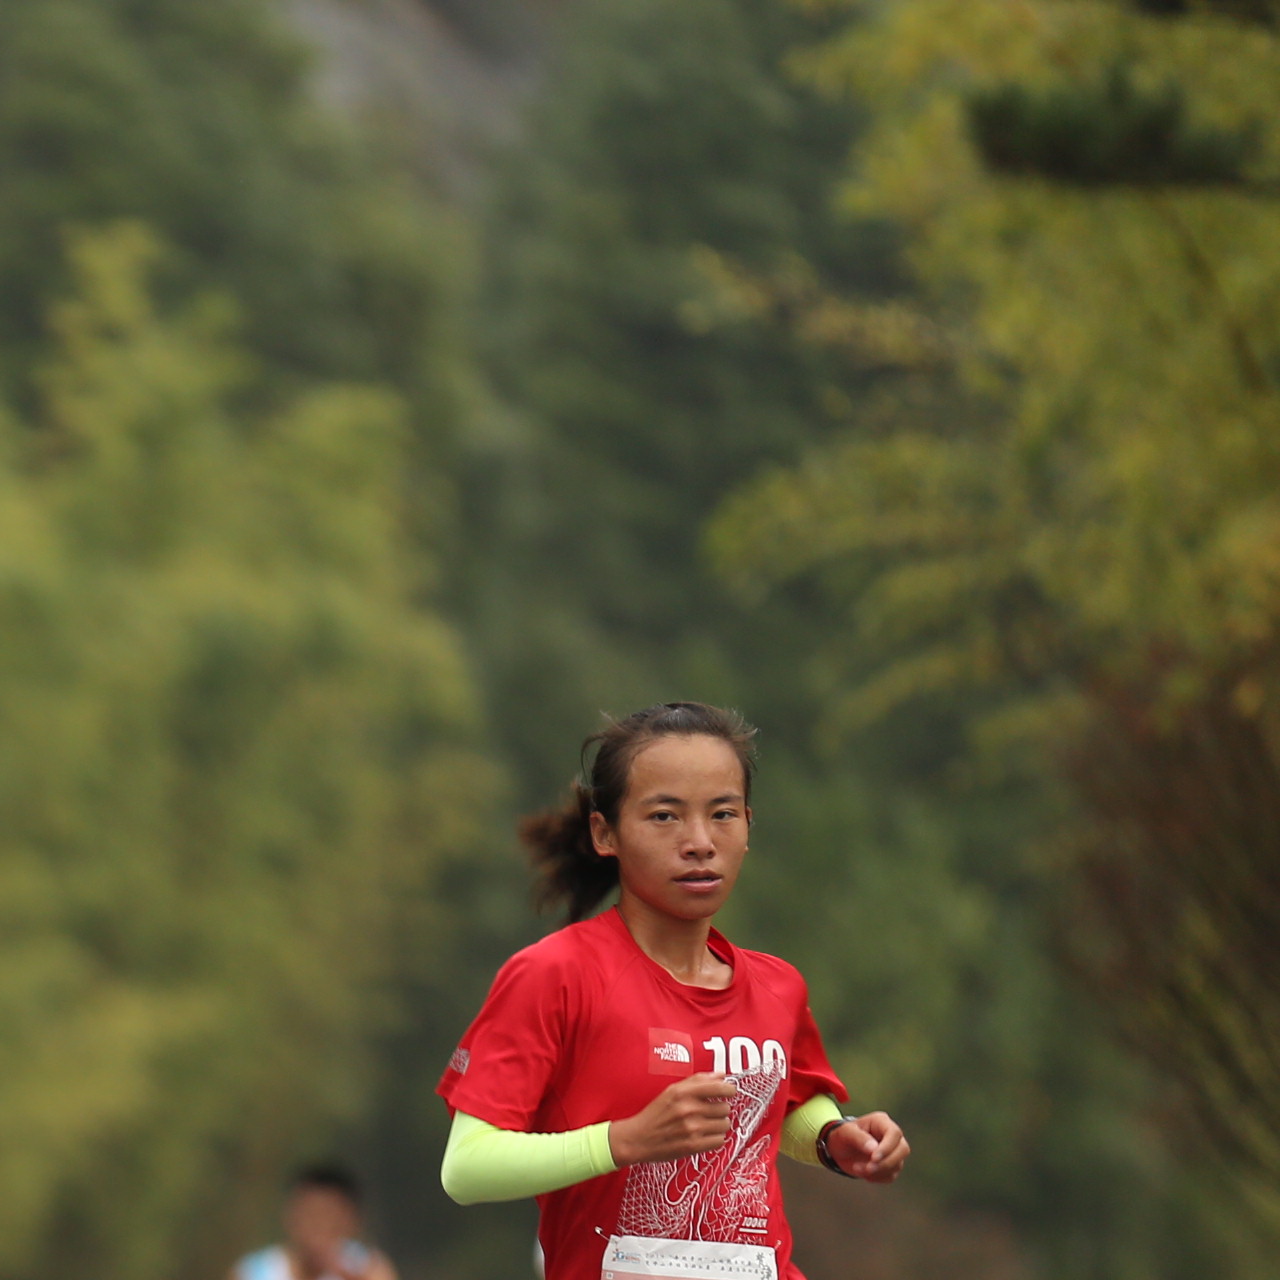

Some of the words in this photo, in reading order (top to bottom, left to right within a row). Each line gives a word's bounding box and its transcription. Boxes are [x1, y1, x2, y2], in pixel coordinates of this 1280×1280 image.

[664, 1042, 679, 1050] THE
[653, 1046, 679, 1056] NORTH
[660, 1053, 679, 1062] FACE
[703, 1036, 787, 1080] 100
